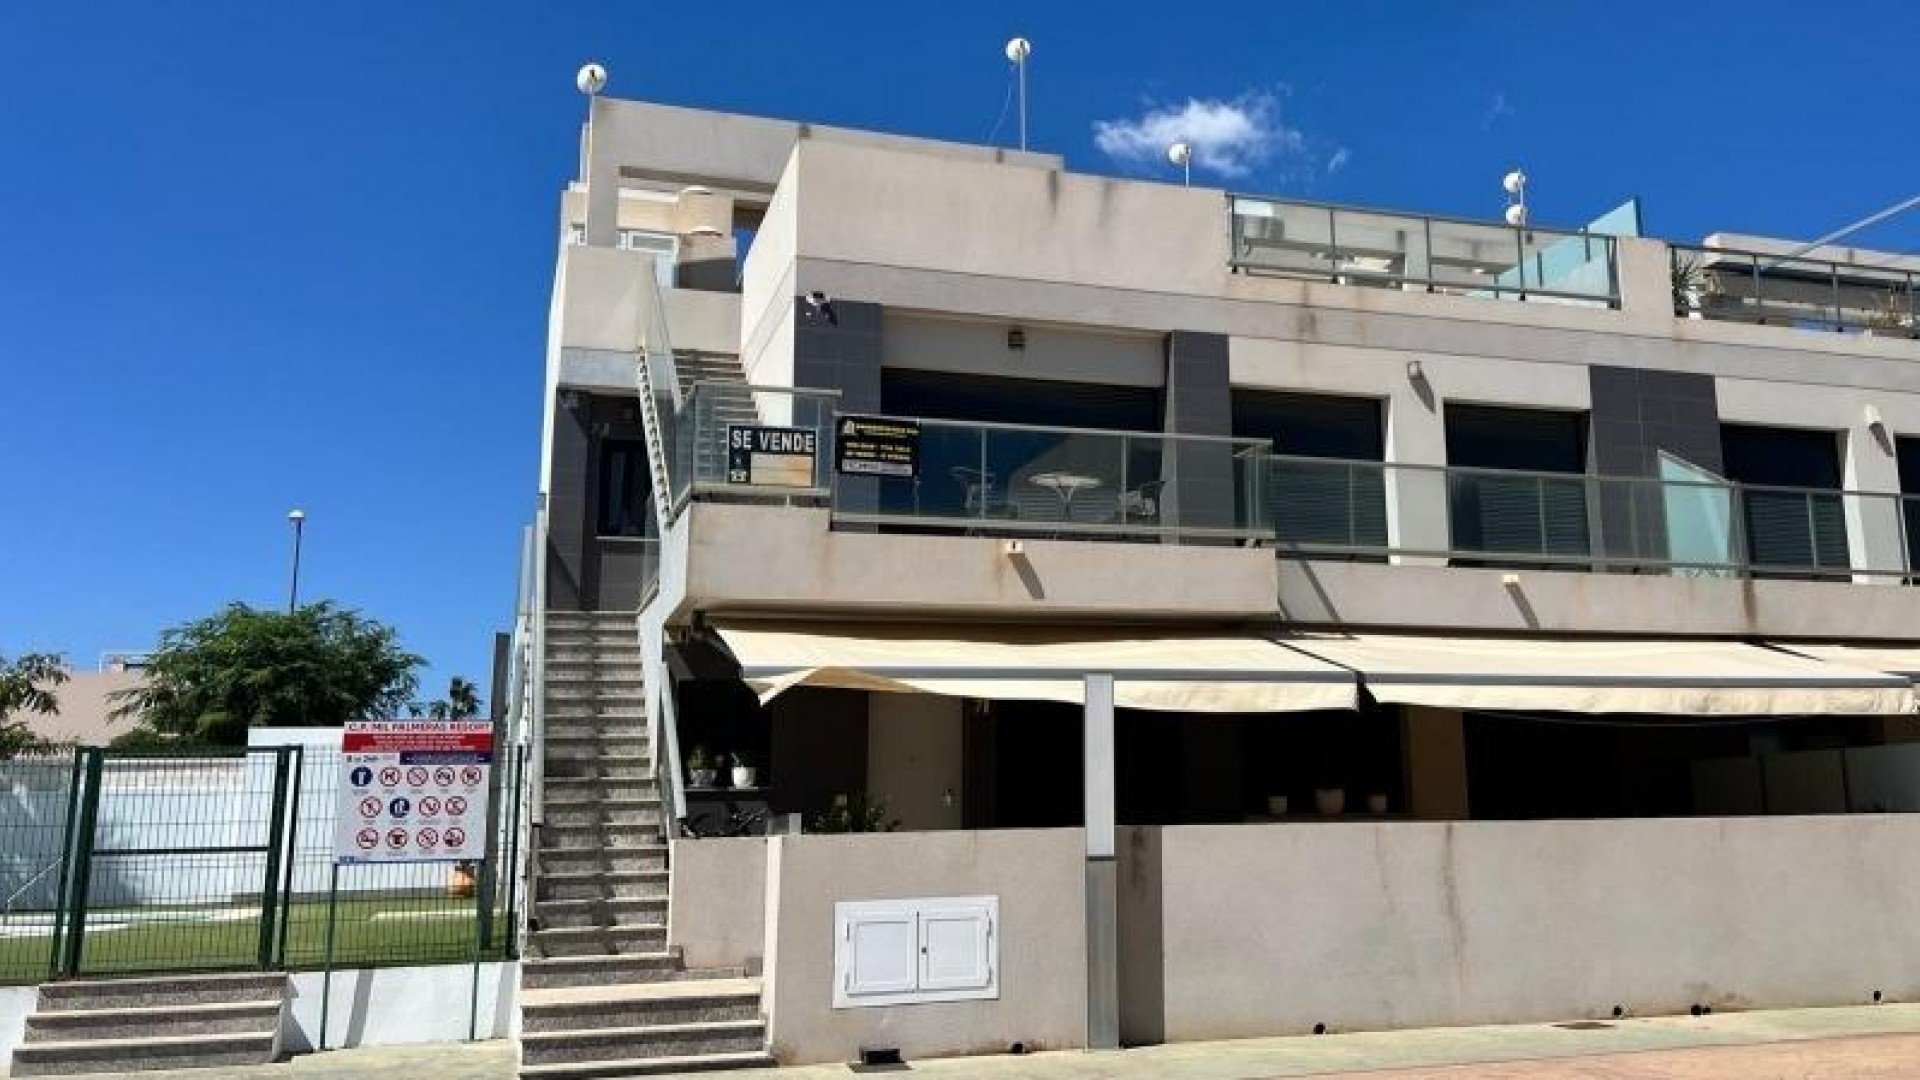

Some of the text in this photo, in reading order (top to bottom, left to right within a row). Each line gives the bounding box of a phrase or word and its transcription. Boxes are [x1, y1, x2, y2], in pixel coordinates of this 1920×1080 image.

[732, 430, 814, 453] SE VENDE
[372, 723, 389, 732] MIL
[391, 723, 446, 732] PALMERAS
[449, 723, 490, 732] RESORT
